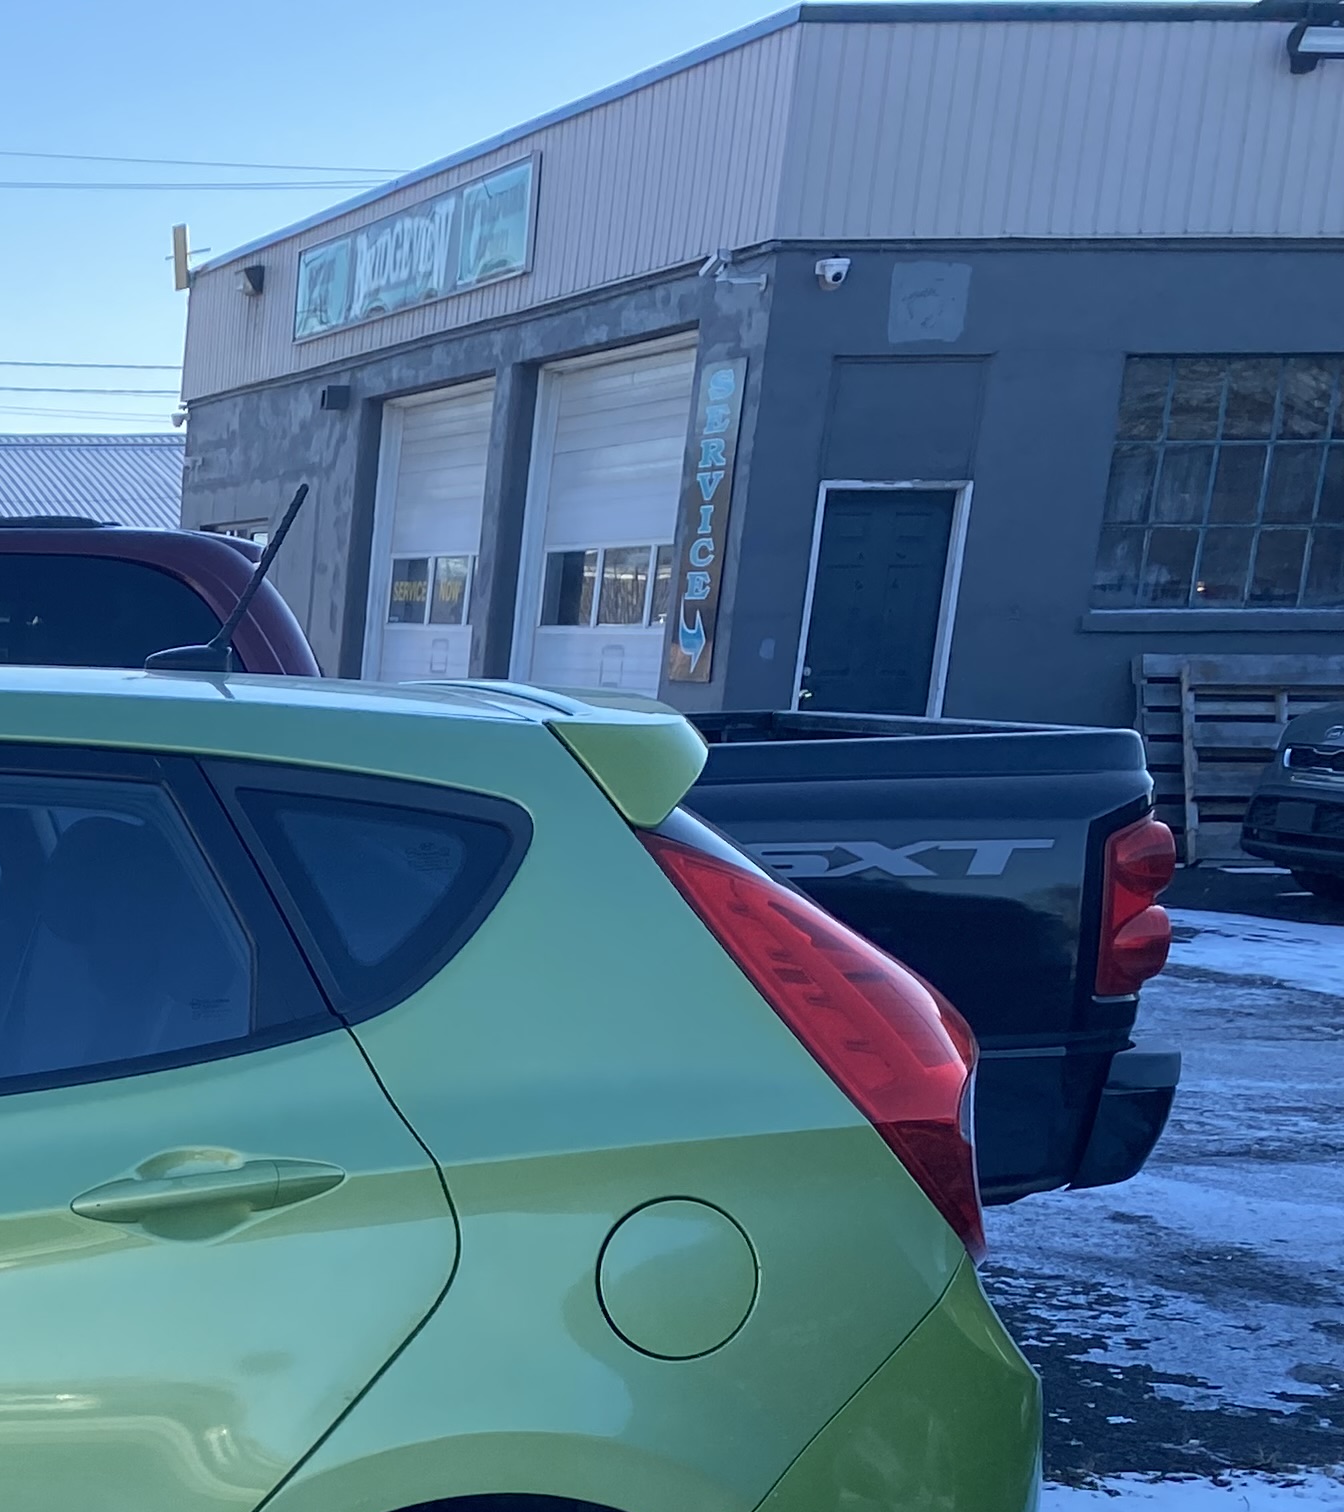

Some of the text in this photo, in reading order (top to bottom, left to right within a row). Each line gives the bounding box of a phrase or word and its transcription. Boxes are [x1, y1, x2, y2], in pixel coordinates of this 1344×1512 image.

[684, 369, 736, 600] SERVICE
[392, 580, 462, 603] SERVICE NOW
[744, 838, 1055, 877] SXT
